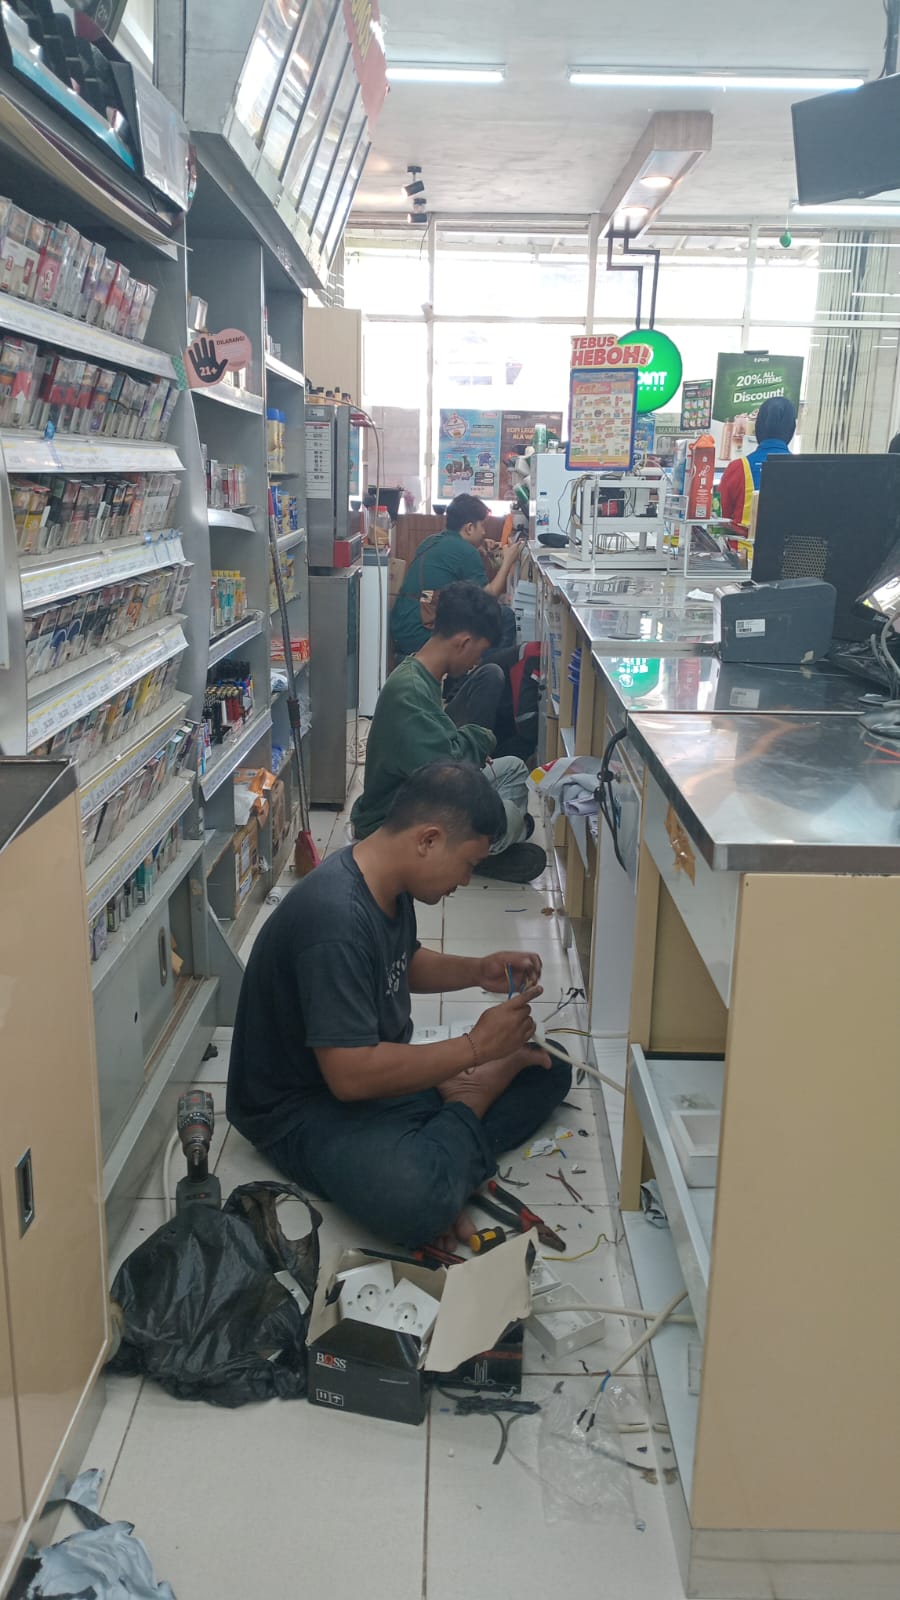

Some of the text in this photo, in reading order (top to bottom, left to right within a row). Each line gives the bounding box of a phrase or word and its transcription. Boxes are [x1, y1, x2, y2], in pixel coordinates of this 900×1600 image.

[571, 336, 615, 349] TEBUS
[571, 345, 650, 366] HEBOH!
[199, 365, 217, 377] 21+
[736, 373, 762, 387] 20%
[762, 375, 784, 385] ITEMS
[733, 387, 785, 403] Discount!
[316, 1352, 347, 1370] BOSS
